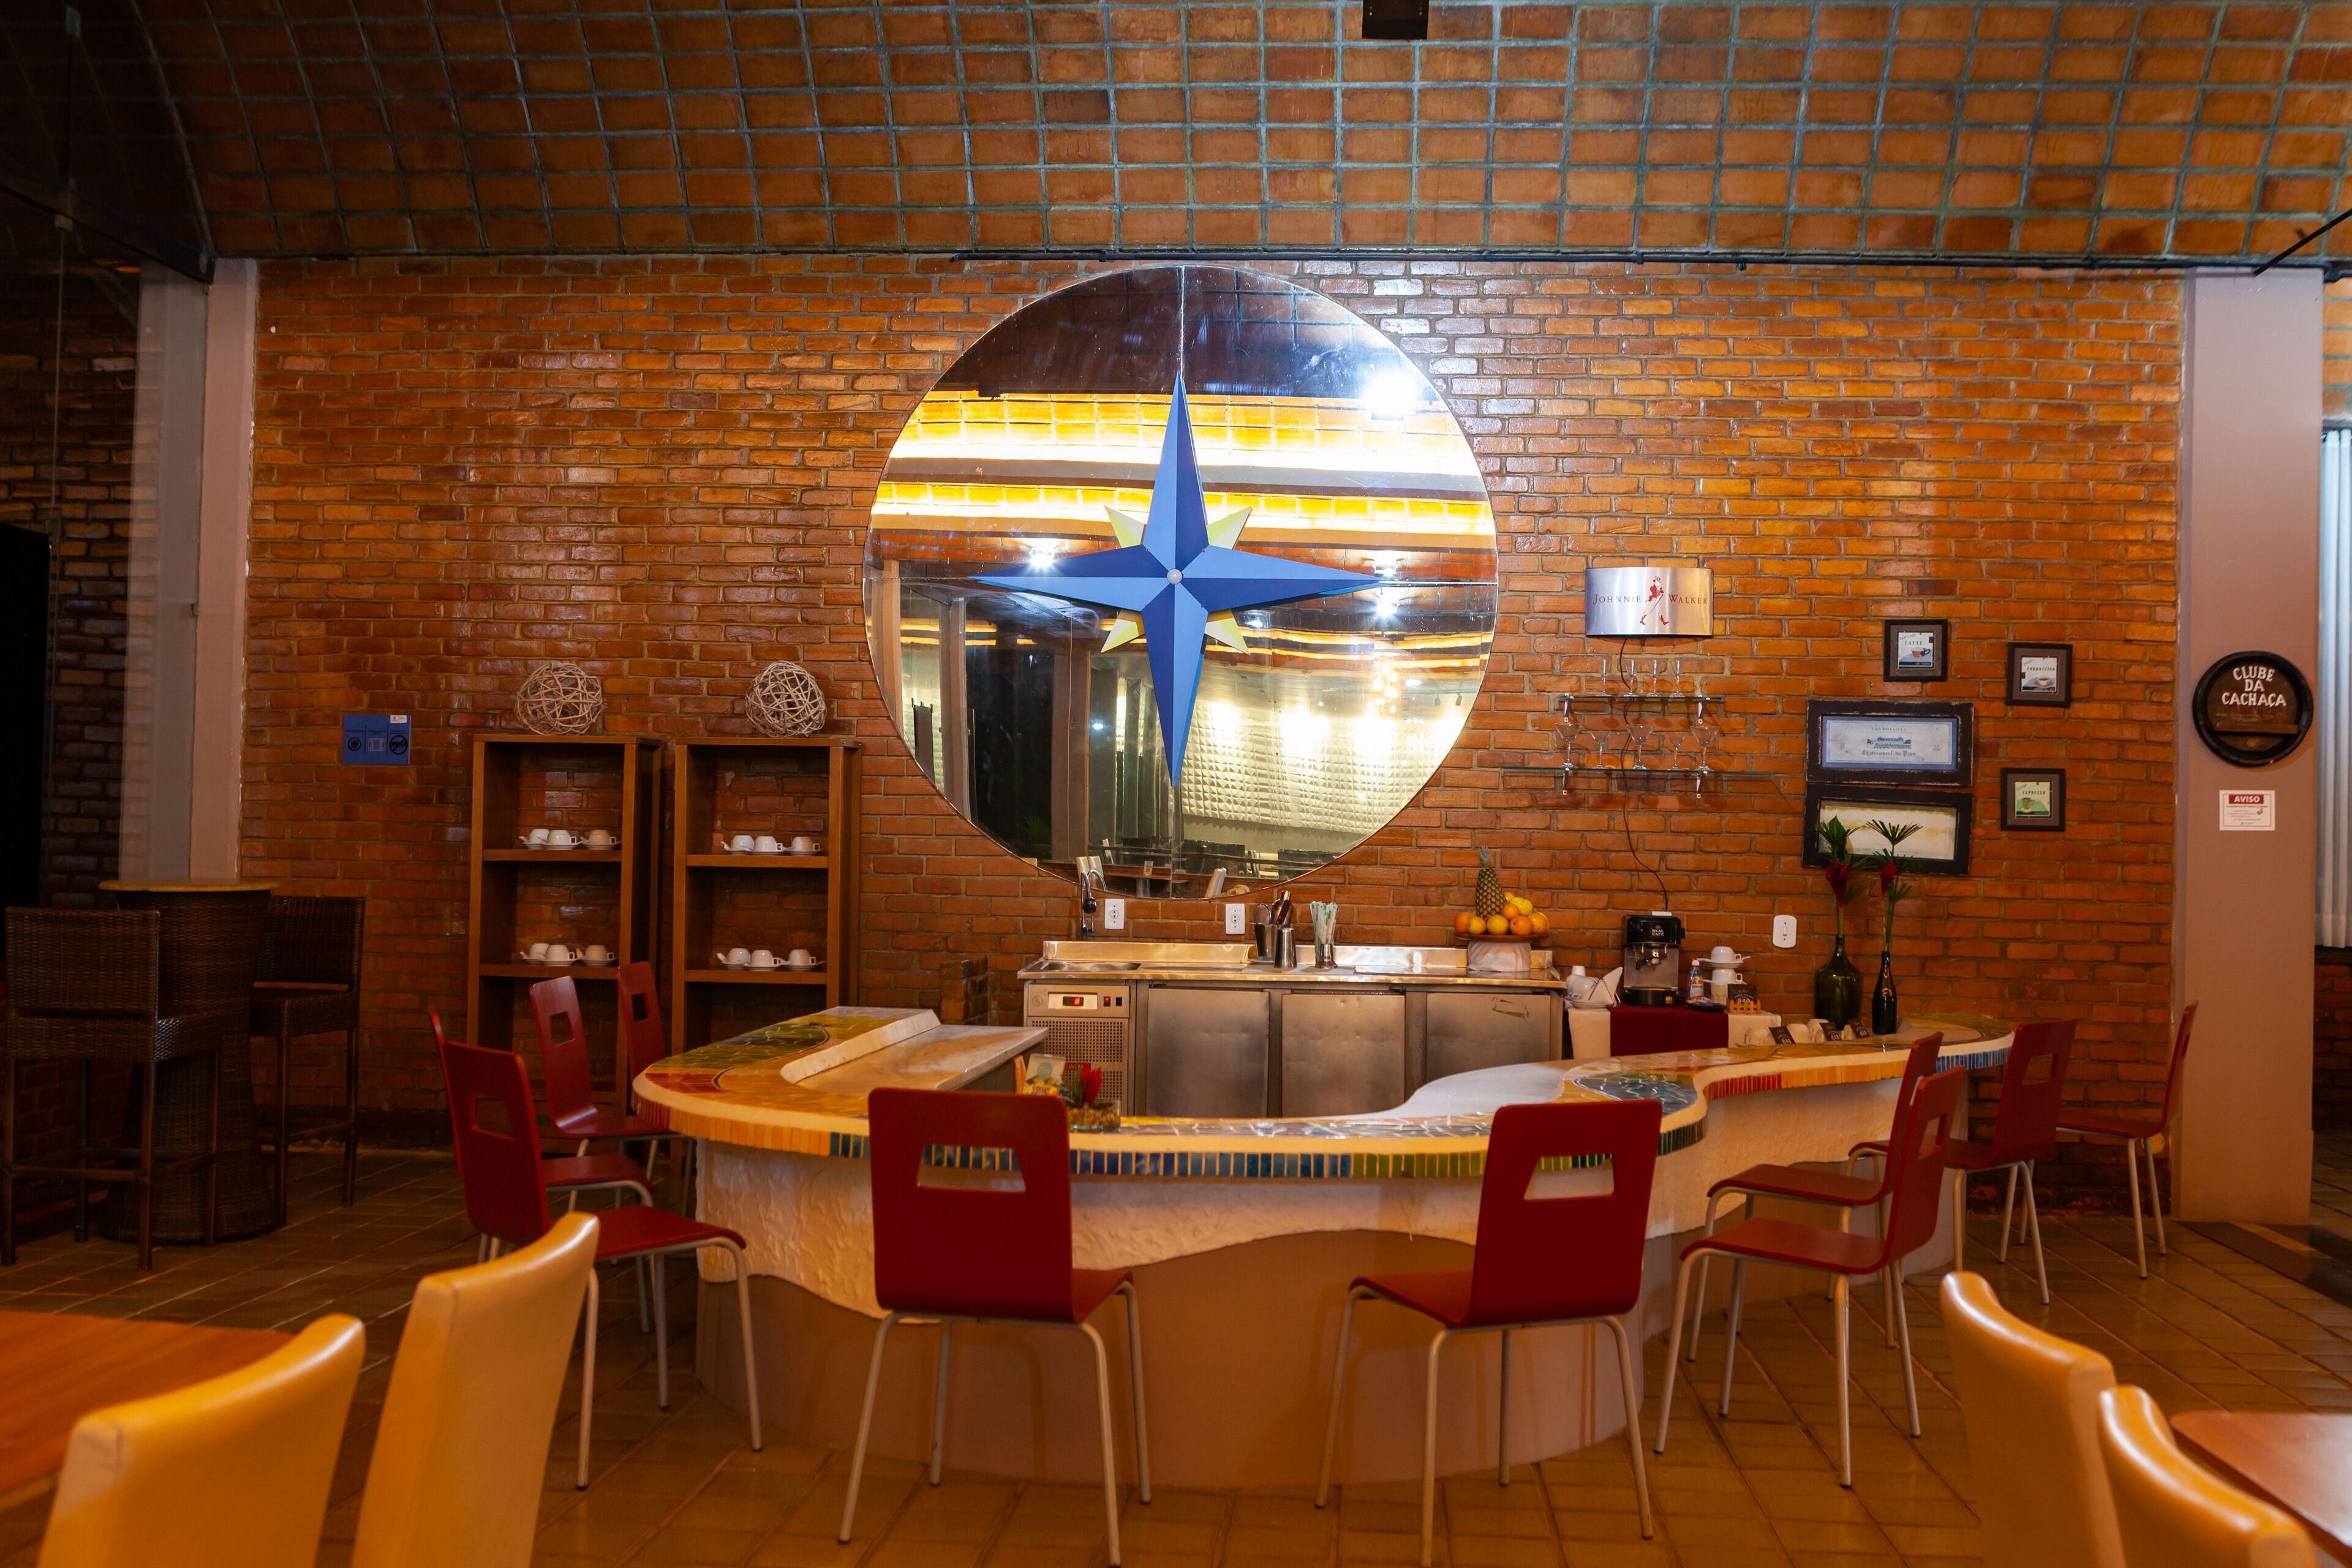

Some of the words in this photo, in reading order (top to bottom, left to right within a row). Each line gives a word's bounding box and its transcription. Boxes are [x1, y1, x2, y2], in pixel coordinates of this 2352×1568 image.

[1593, 594, 1642, 605] JOHNNIE
[1668, 594, 1708, 605] WALKER
[2233, 666, 2275, 682] CLUBE
[2244, 679, 2265, 692] DA
[2222, 692, 2287, 707] CACHAÇA
